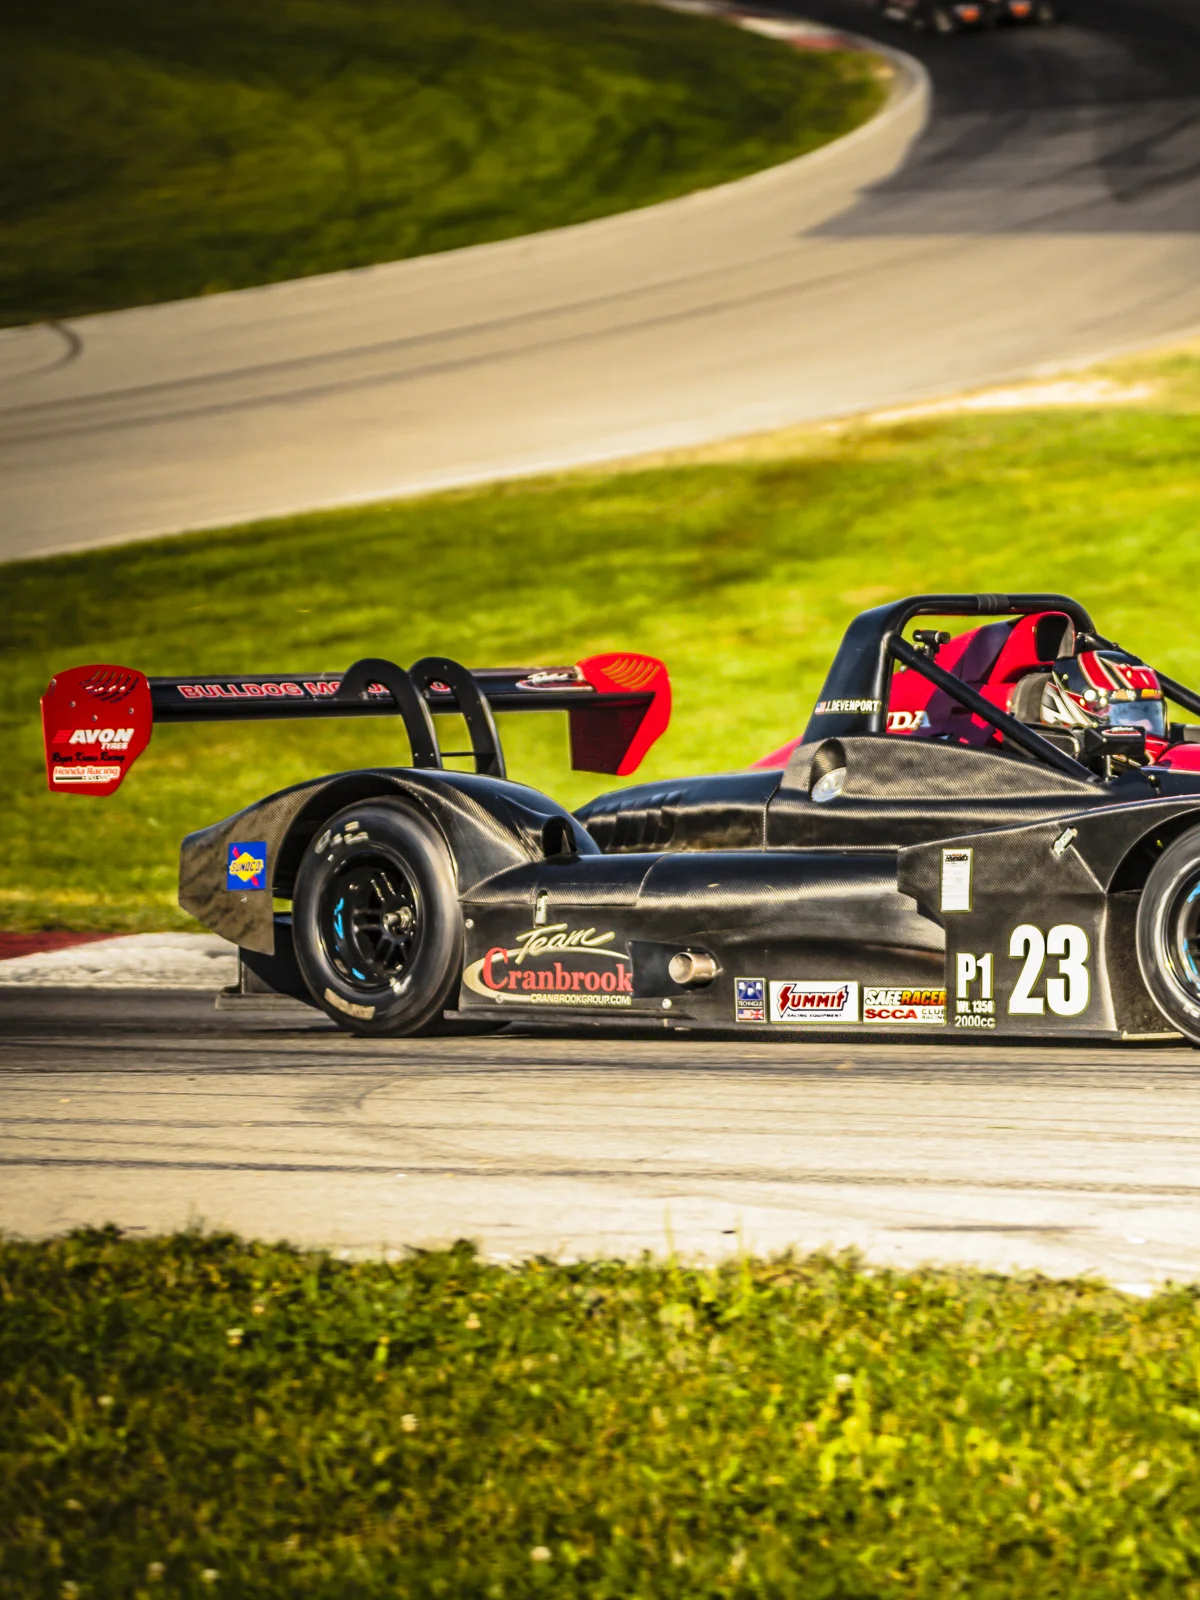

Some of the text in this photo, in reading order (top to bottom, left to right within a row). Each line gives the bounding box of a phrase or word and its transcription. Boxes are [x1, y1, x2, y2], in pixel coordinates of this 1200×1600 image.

[177, 683, 304, 698] BULLDOG
[68, 727, 135, 745] AVON
[515, 923, 615, 964] Team
[482, 947, 634, 992] Cranbrook
[957, 953, 994, 998] P1
[1008, 924, 1090, 1016] 23
[530, 993, 631, 1005] CRANBROOKGROUP.COM
[779, 985, 846, 1013] SUMMIT
[865, 1009, 918, 1019] SCCA
[954, 1014, 996, 1029] 2000cc
